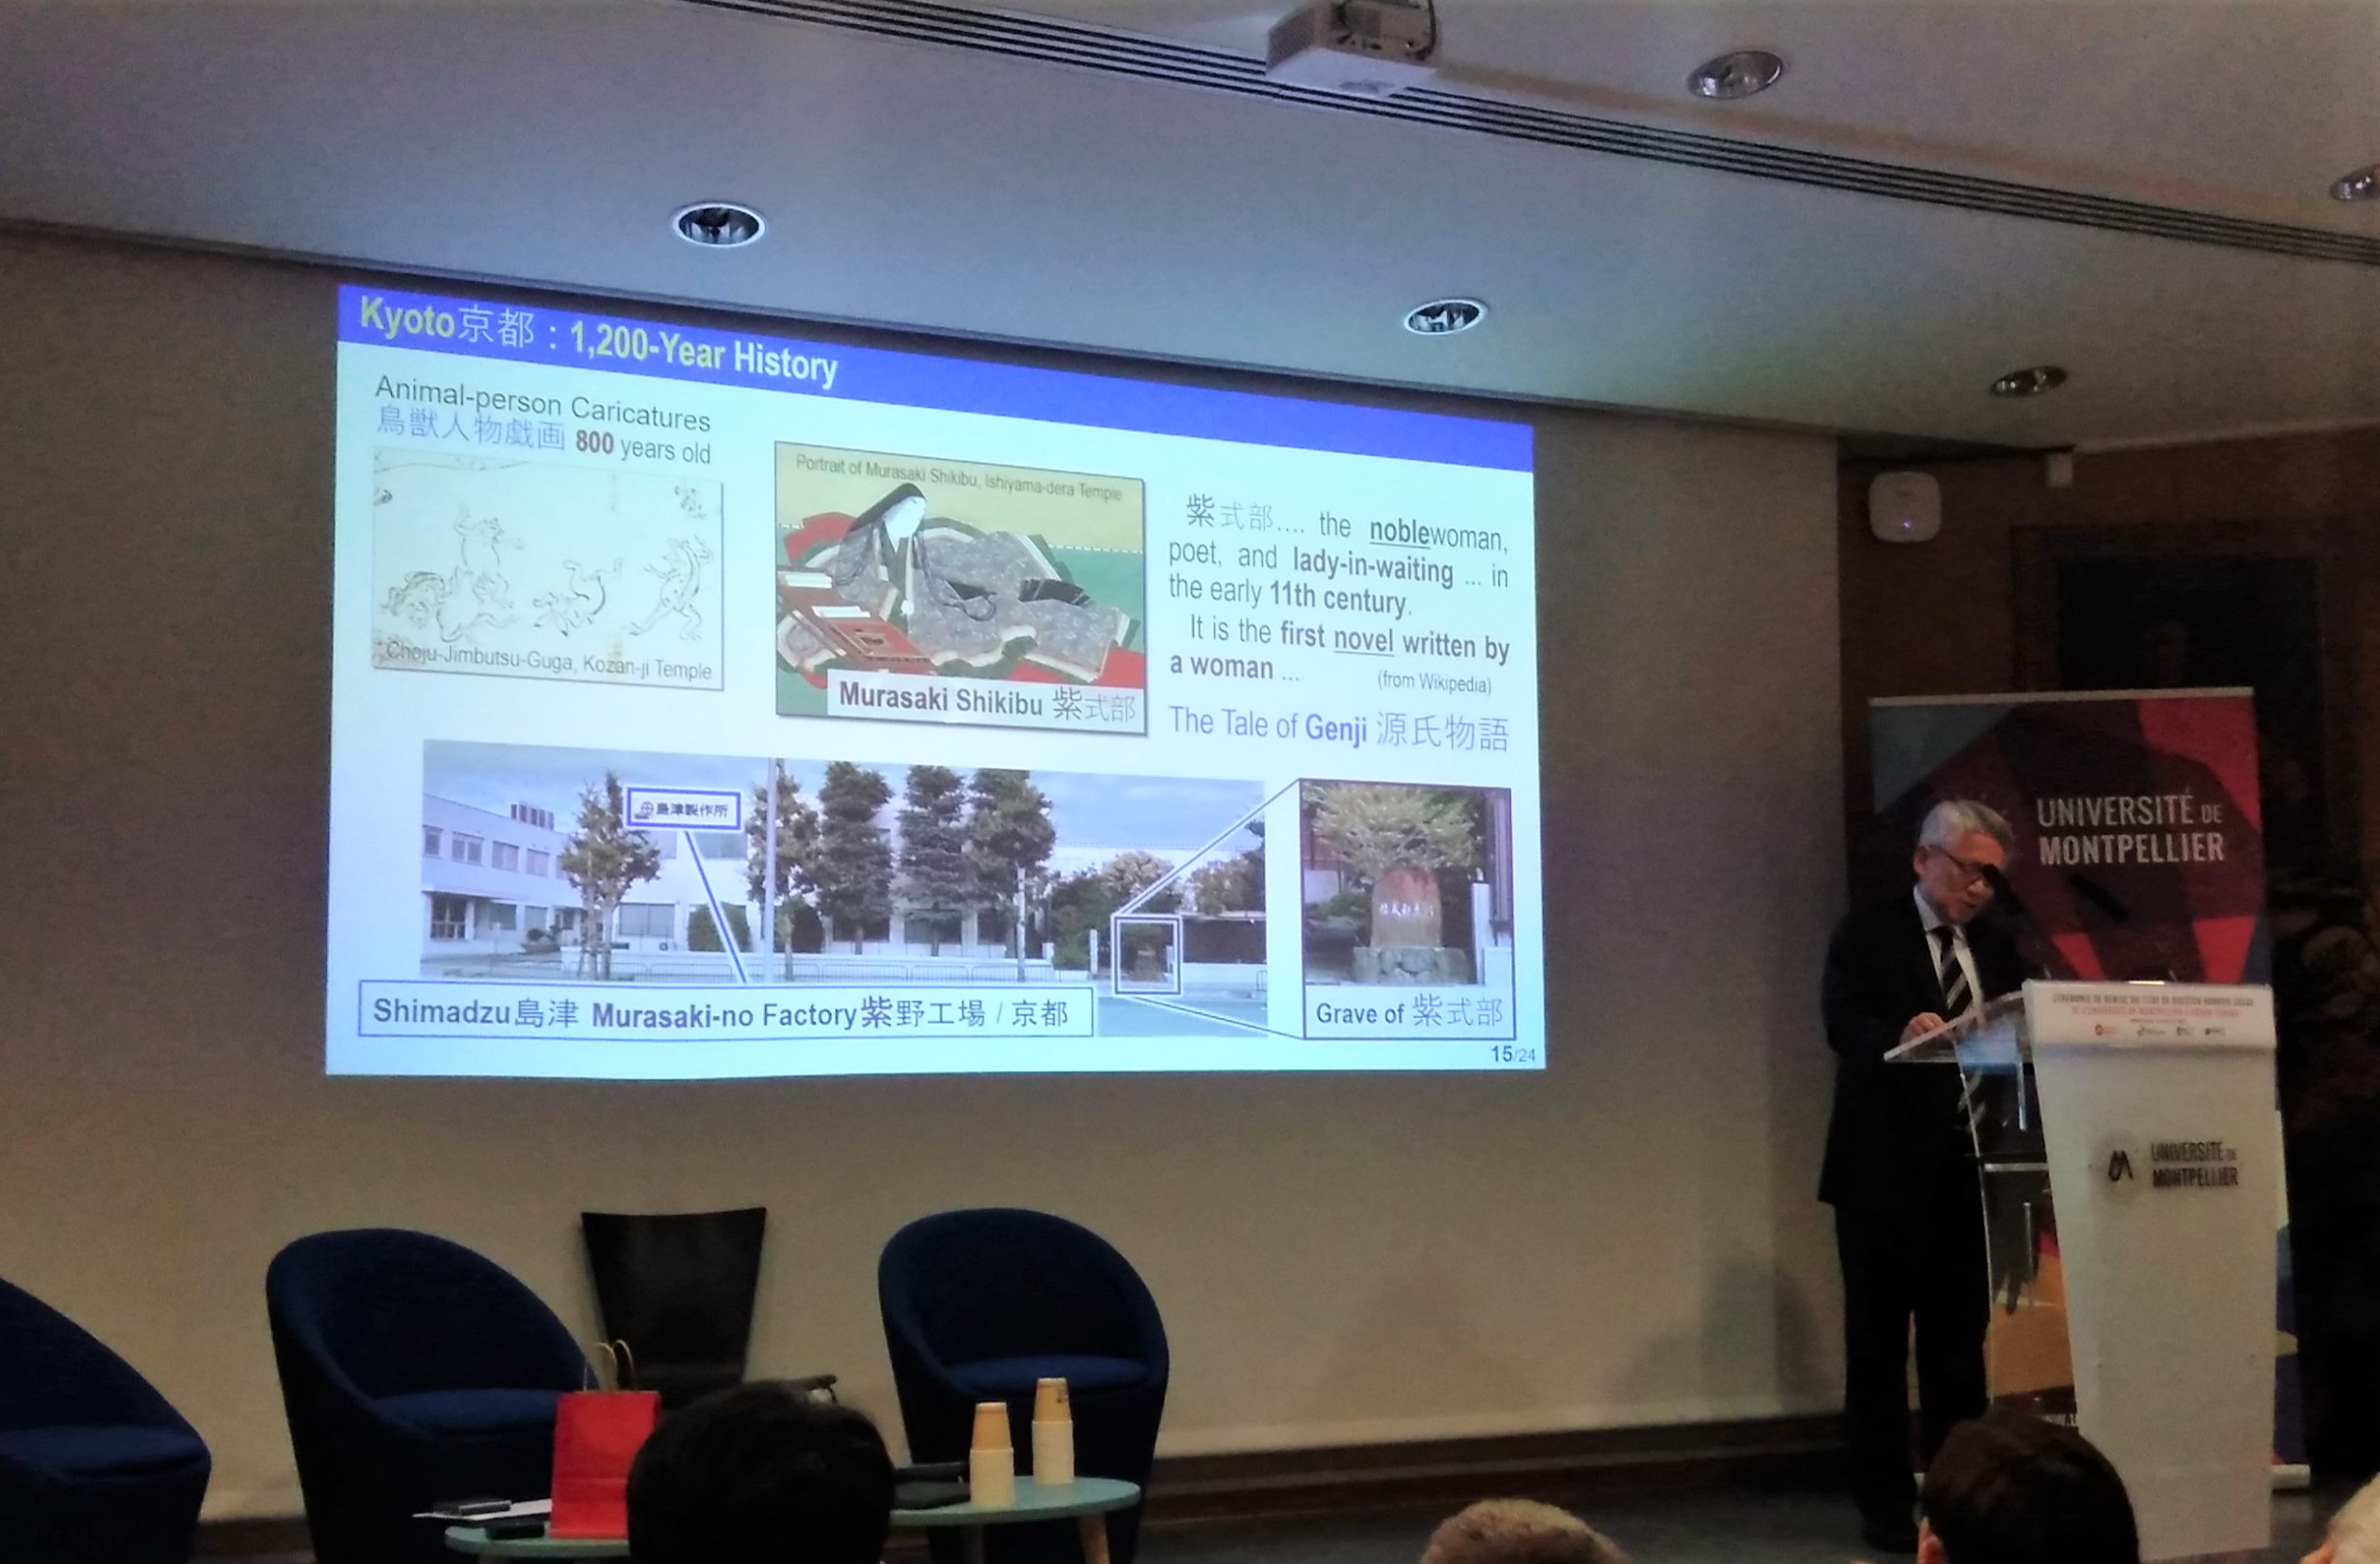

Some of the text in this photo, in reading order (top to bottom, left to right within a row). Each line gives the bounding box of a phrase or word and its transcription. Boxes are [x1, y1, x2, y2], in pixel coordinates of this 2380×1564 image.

[571, 320, 725, 369] 1,200-Year
[734, 340, 838, 390] History
[375, 375, 711, 432] Animal-person Caricatures
[376, 403, 711, 464] 鳥獣人物戯画 800 years old
[796, 454, 846, 476] Portrait
[850, 461, 862, 476] of
[866, 462, 926, 483] Murasaki
[985, 473, 1074, 496] Ishiyama-dera
[1080, 483, 1122, 502] Temple
[1319, 511, 1351, 537] the
[1370, 518, 1508, 554] noblewoman,
[1169, 540, 1222, 566] poet,
[1238, 544, 1277, 569] and
[1294, 546, 1454, 589] lady-in-waiting
[1493, 563, 1508, 588] in
[1169, 573, 1412, 621] the early 11th century.
[1191, 614, 1509, 666] It is the first novel written by
[583, 655, 649, 680] Kozan-ji
[656, 659, 712, 682] Temple
[1171, 654, 1182, 674] a
[1191, 655, 1273, 680] woman
[1377, 670, 1414, 690] (from
[1419, 673, 1492, 696] Wikipedia)
[840, 681, 1136, 722] Murasaki Shikibu 紫式部
[1169, 705, 1509, 751] The Tale of Genji 源氏物語
[2037, 786, 2223, 827] UNIVERSITÉ DE
[2040, 832, 2225, 865] MONTPELLIER
[593, 1003, 754, 1029] Murasaki-no
[1012, 999, 1068, 1028] 京都
[1316, 993, 1502, 1028] Grave of 紫式部
[1491, 1045, 1535, 1063] 15/24
[2153, 1167, 2238, 1188] MONTPELLIER
